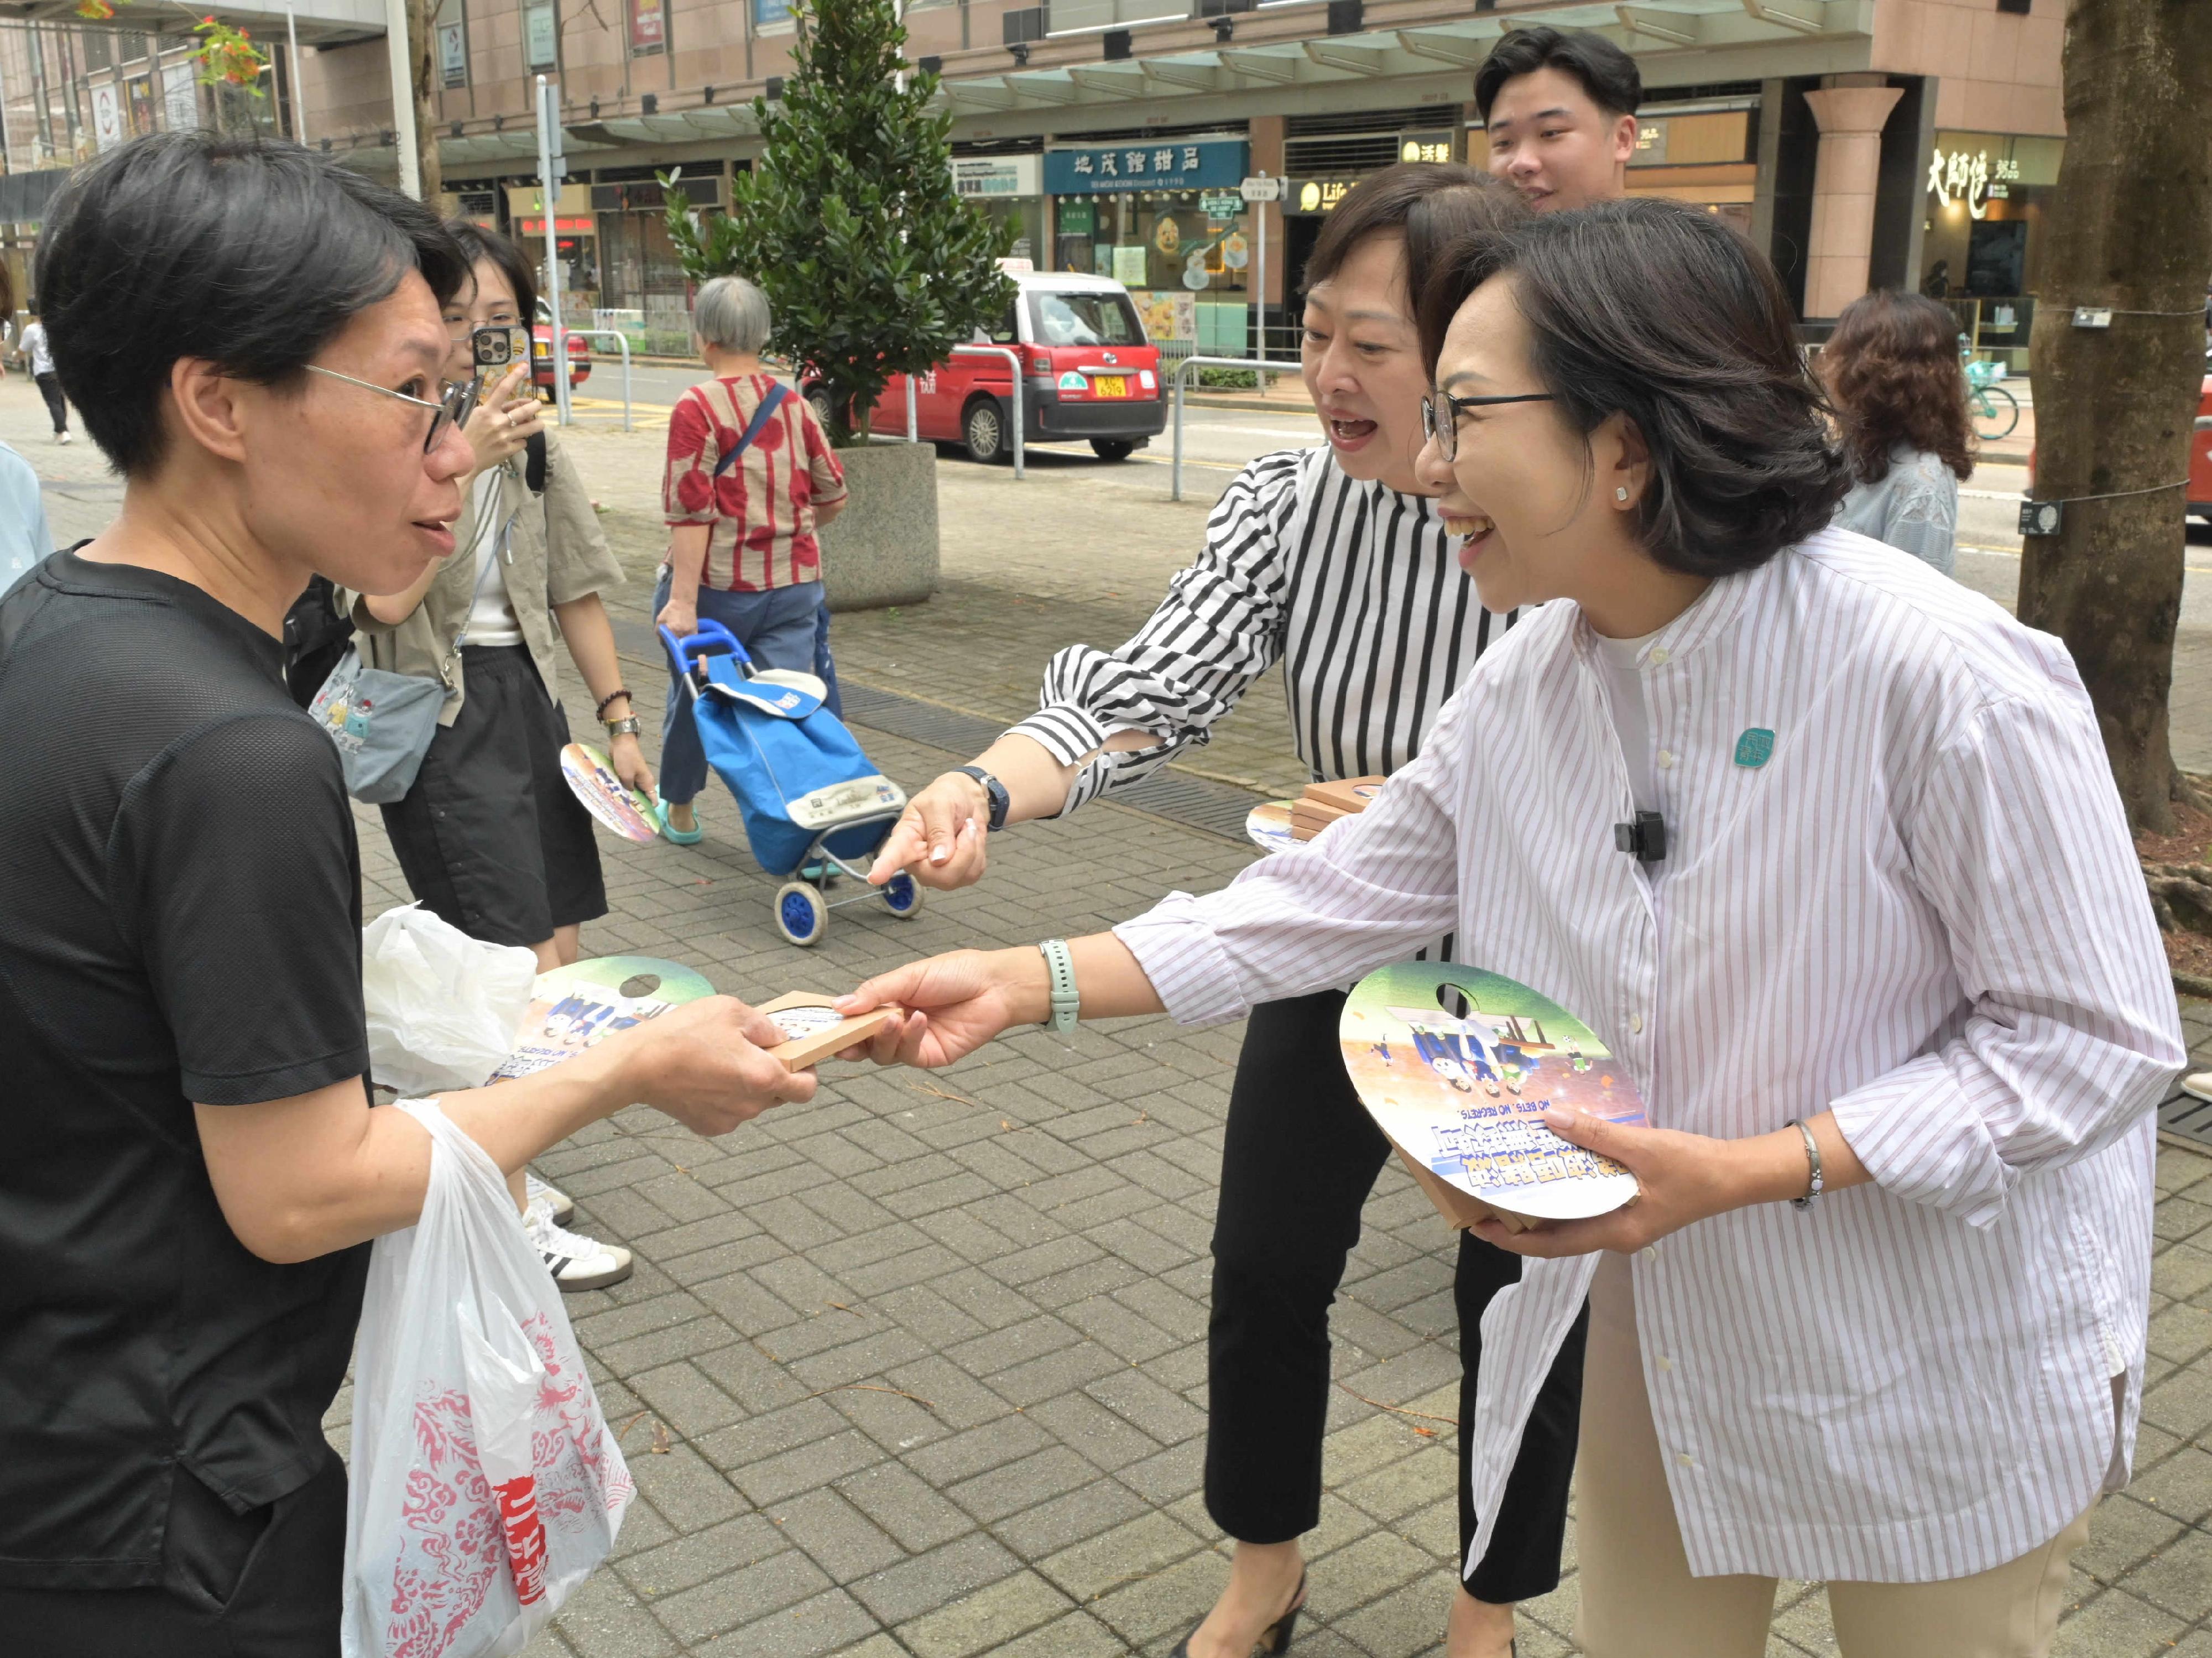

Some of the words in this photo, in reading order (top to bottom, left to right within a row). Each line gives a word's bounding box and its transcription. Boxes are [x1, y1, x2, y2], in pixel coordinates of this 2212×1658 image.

[920, 381, 936, 394] TAXI
[1101, 387, 1122, 395] 6219
[1498, 1104, 1512, 1116] NO
[1539, 1099, 1551, 1111] NO
